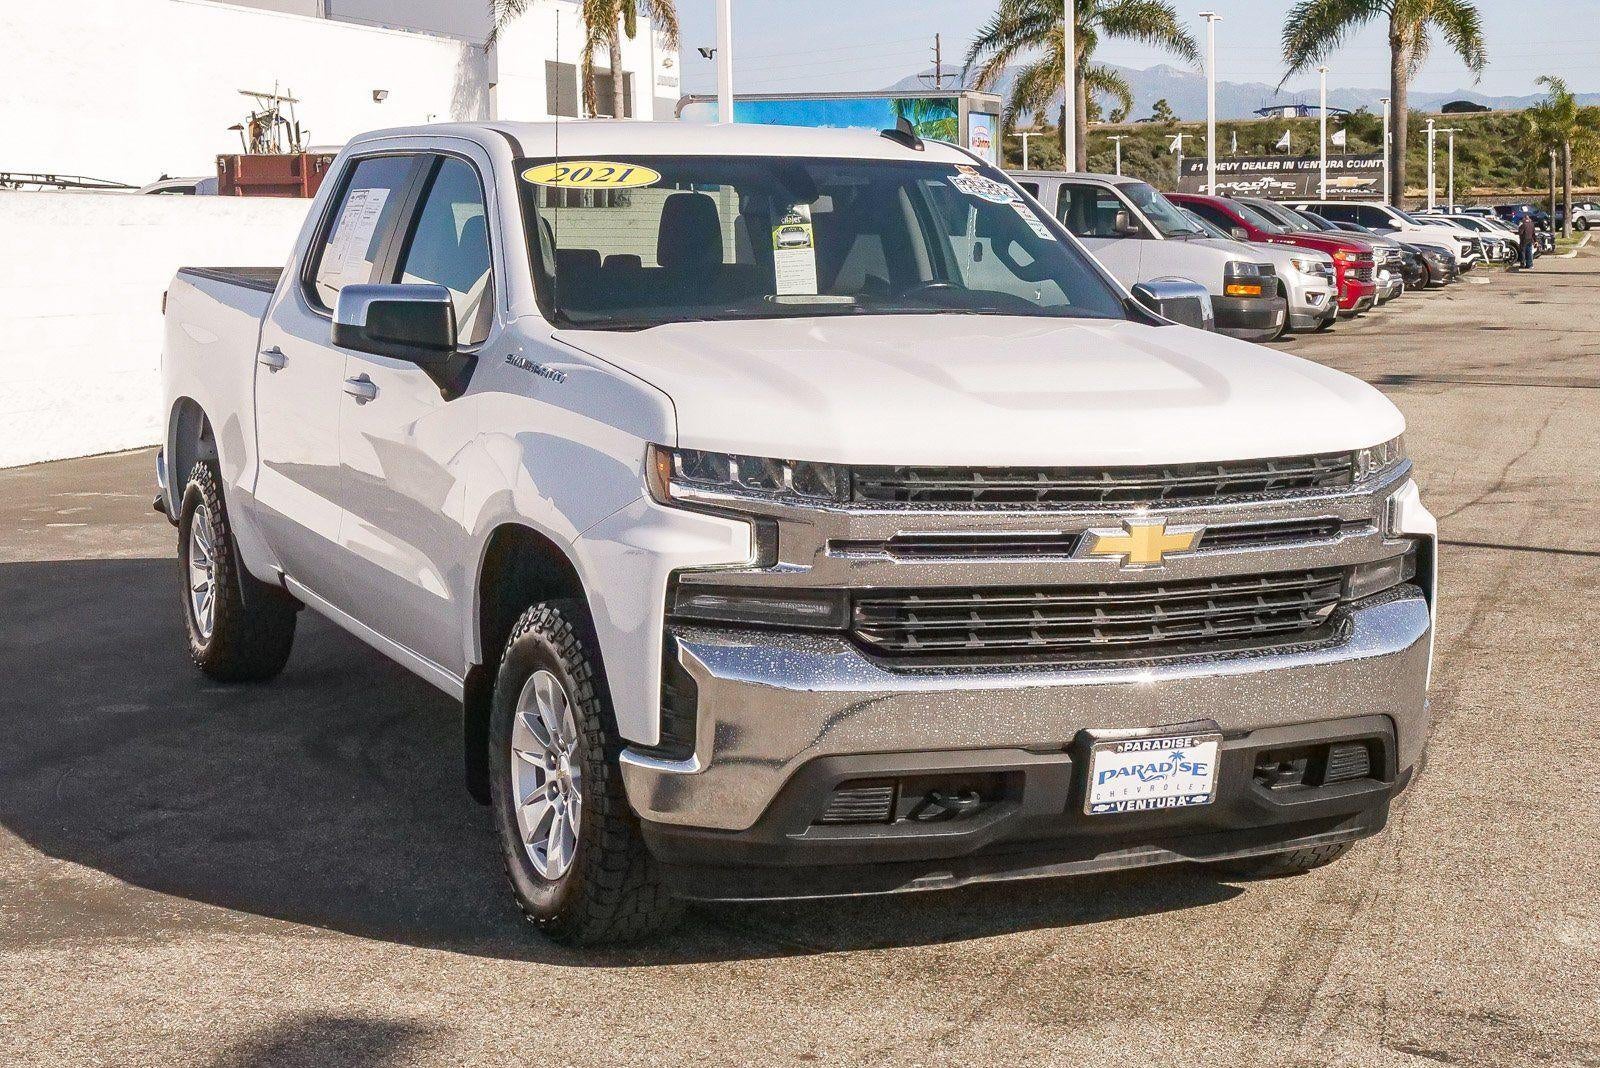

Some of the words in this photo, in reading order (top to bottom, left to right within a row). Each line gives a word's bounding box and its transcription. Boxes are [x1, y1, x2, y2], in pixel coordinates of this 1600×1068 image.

[1190, 163, 1203, 172] #1
[1206, 162, 1240, 171] HEVY
[1242, 161, 1280, 170] DEALER
[1283, 161, 1294, 169] IN
[545, 167, 635, 182] 2021
[1124, 738, 1192, 752] PARADISE
[1098, 753, 1208, 785] PARADISE
[1097, 784, 1206, 801] CHEVROLET
[1116, 796, 1187, 811] VENTURA
